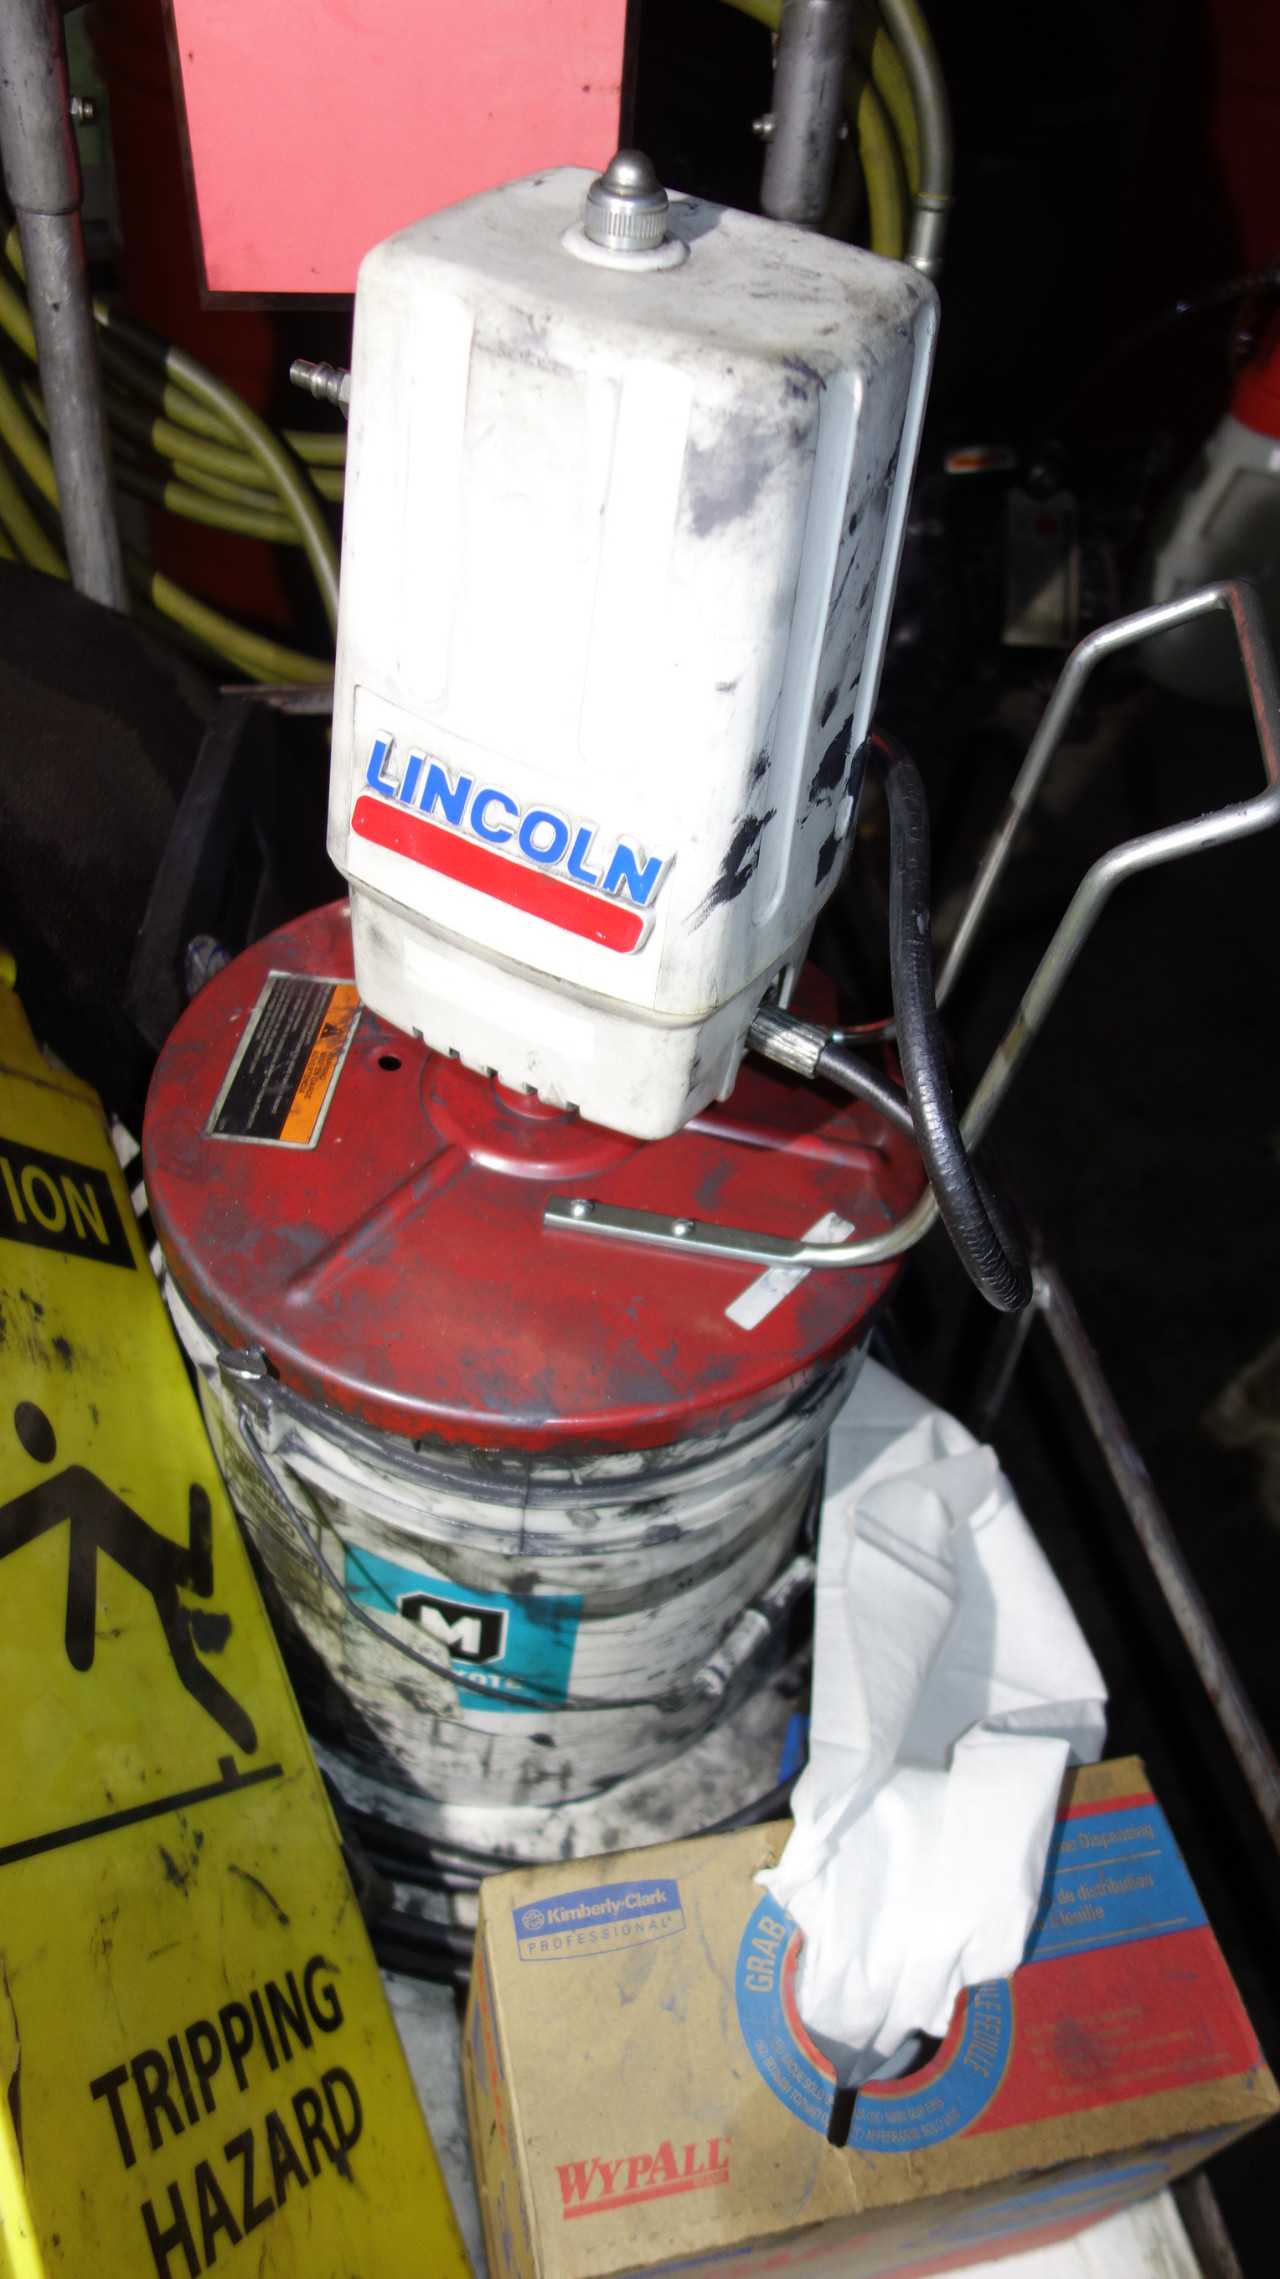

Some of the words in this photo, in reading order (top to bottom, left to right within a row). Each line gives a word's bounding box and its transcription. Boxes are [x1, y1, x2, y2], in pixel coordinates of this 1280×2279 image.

[365, 738, 663, 906] LINCOLN
[527, 1917, 673, 1953] PROFESSIONAL
[547, 1887, 668, 1924] Kimberly-Clark
[744, 1914, 785, 1993] GRAB
[89, 1954, 344, 2170] TRIPPING
[140, 2066, 364, 2279] HAZARD
